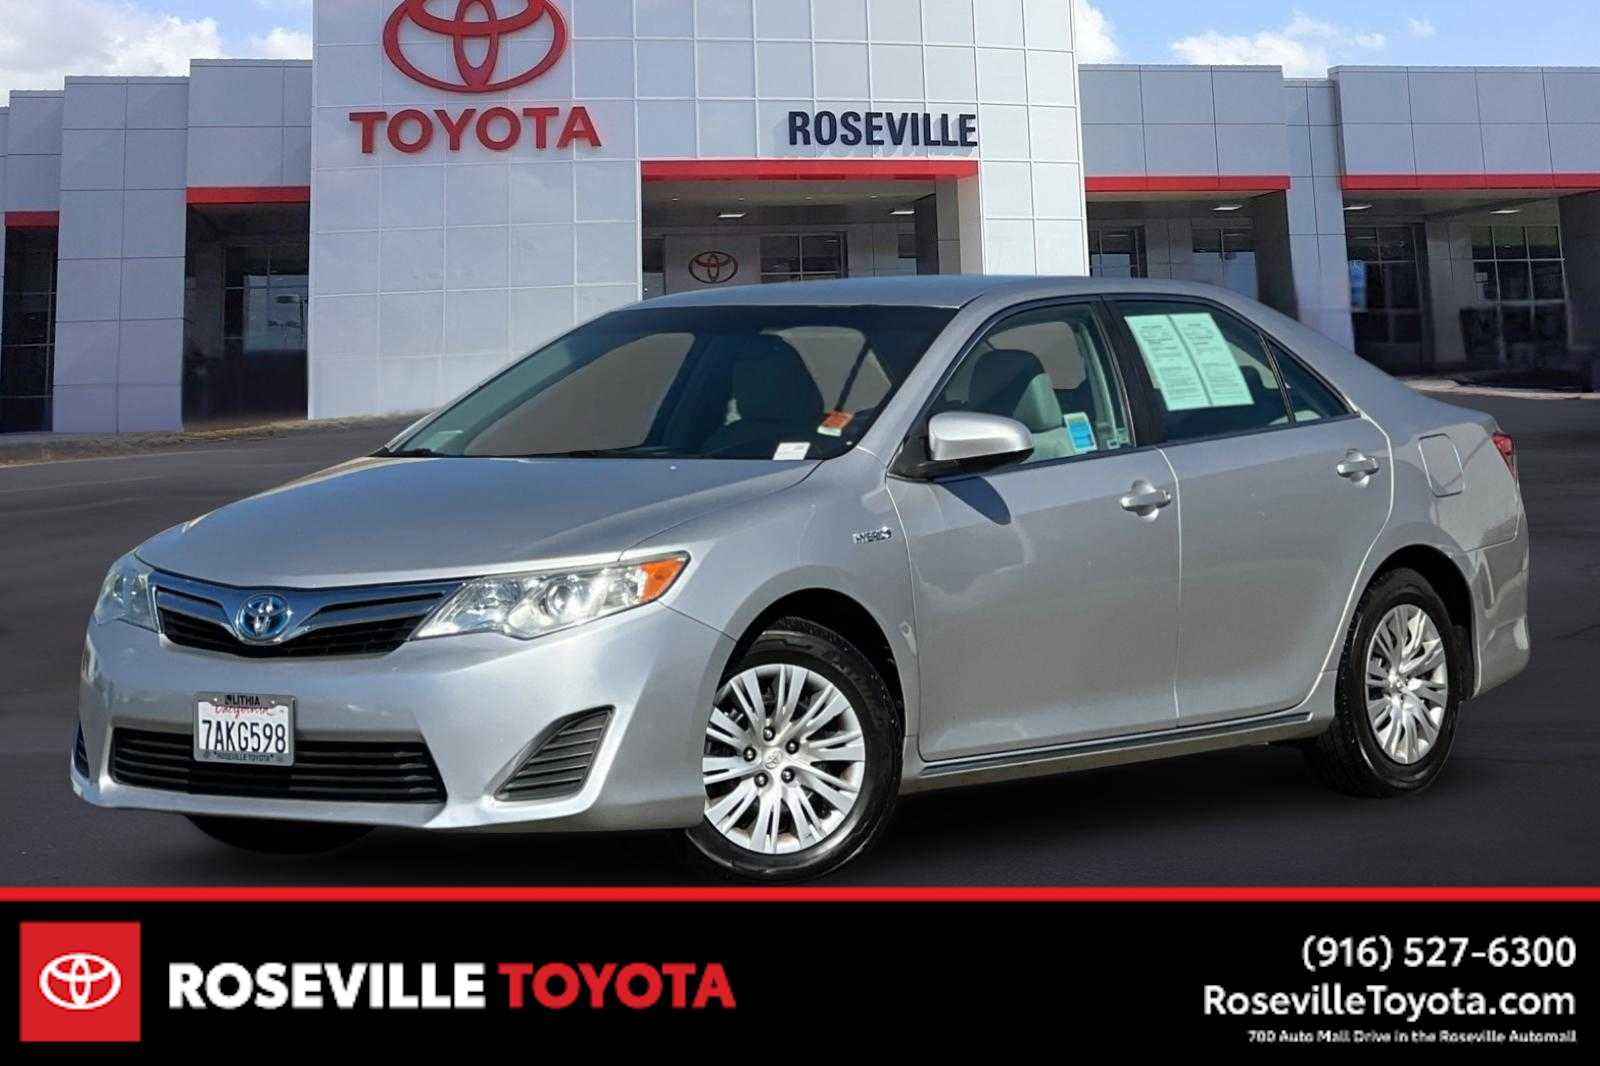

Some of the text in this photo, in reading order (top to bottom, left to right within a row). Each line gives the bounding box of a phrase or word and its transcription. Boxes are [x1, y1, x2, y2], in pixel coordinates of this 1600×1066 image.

[349, 106, 603, 154] TOYOTA
[787, 110, 979, 147] ROSEVILLE
[232, 695, 261, 707] LITHIA
[202, 719, 287, 754] 7AKG598
